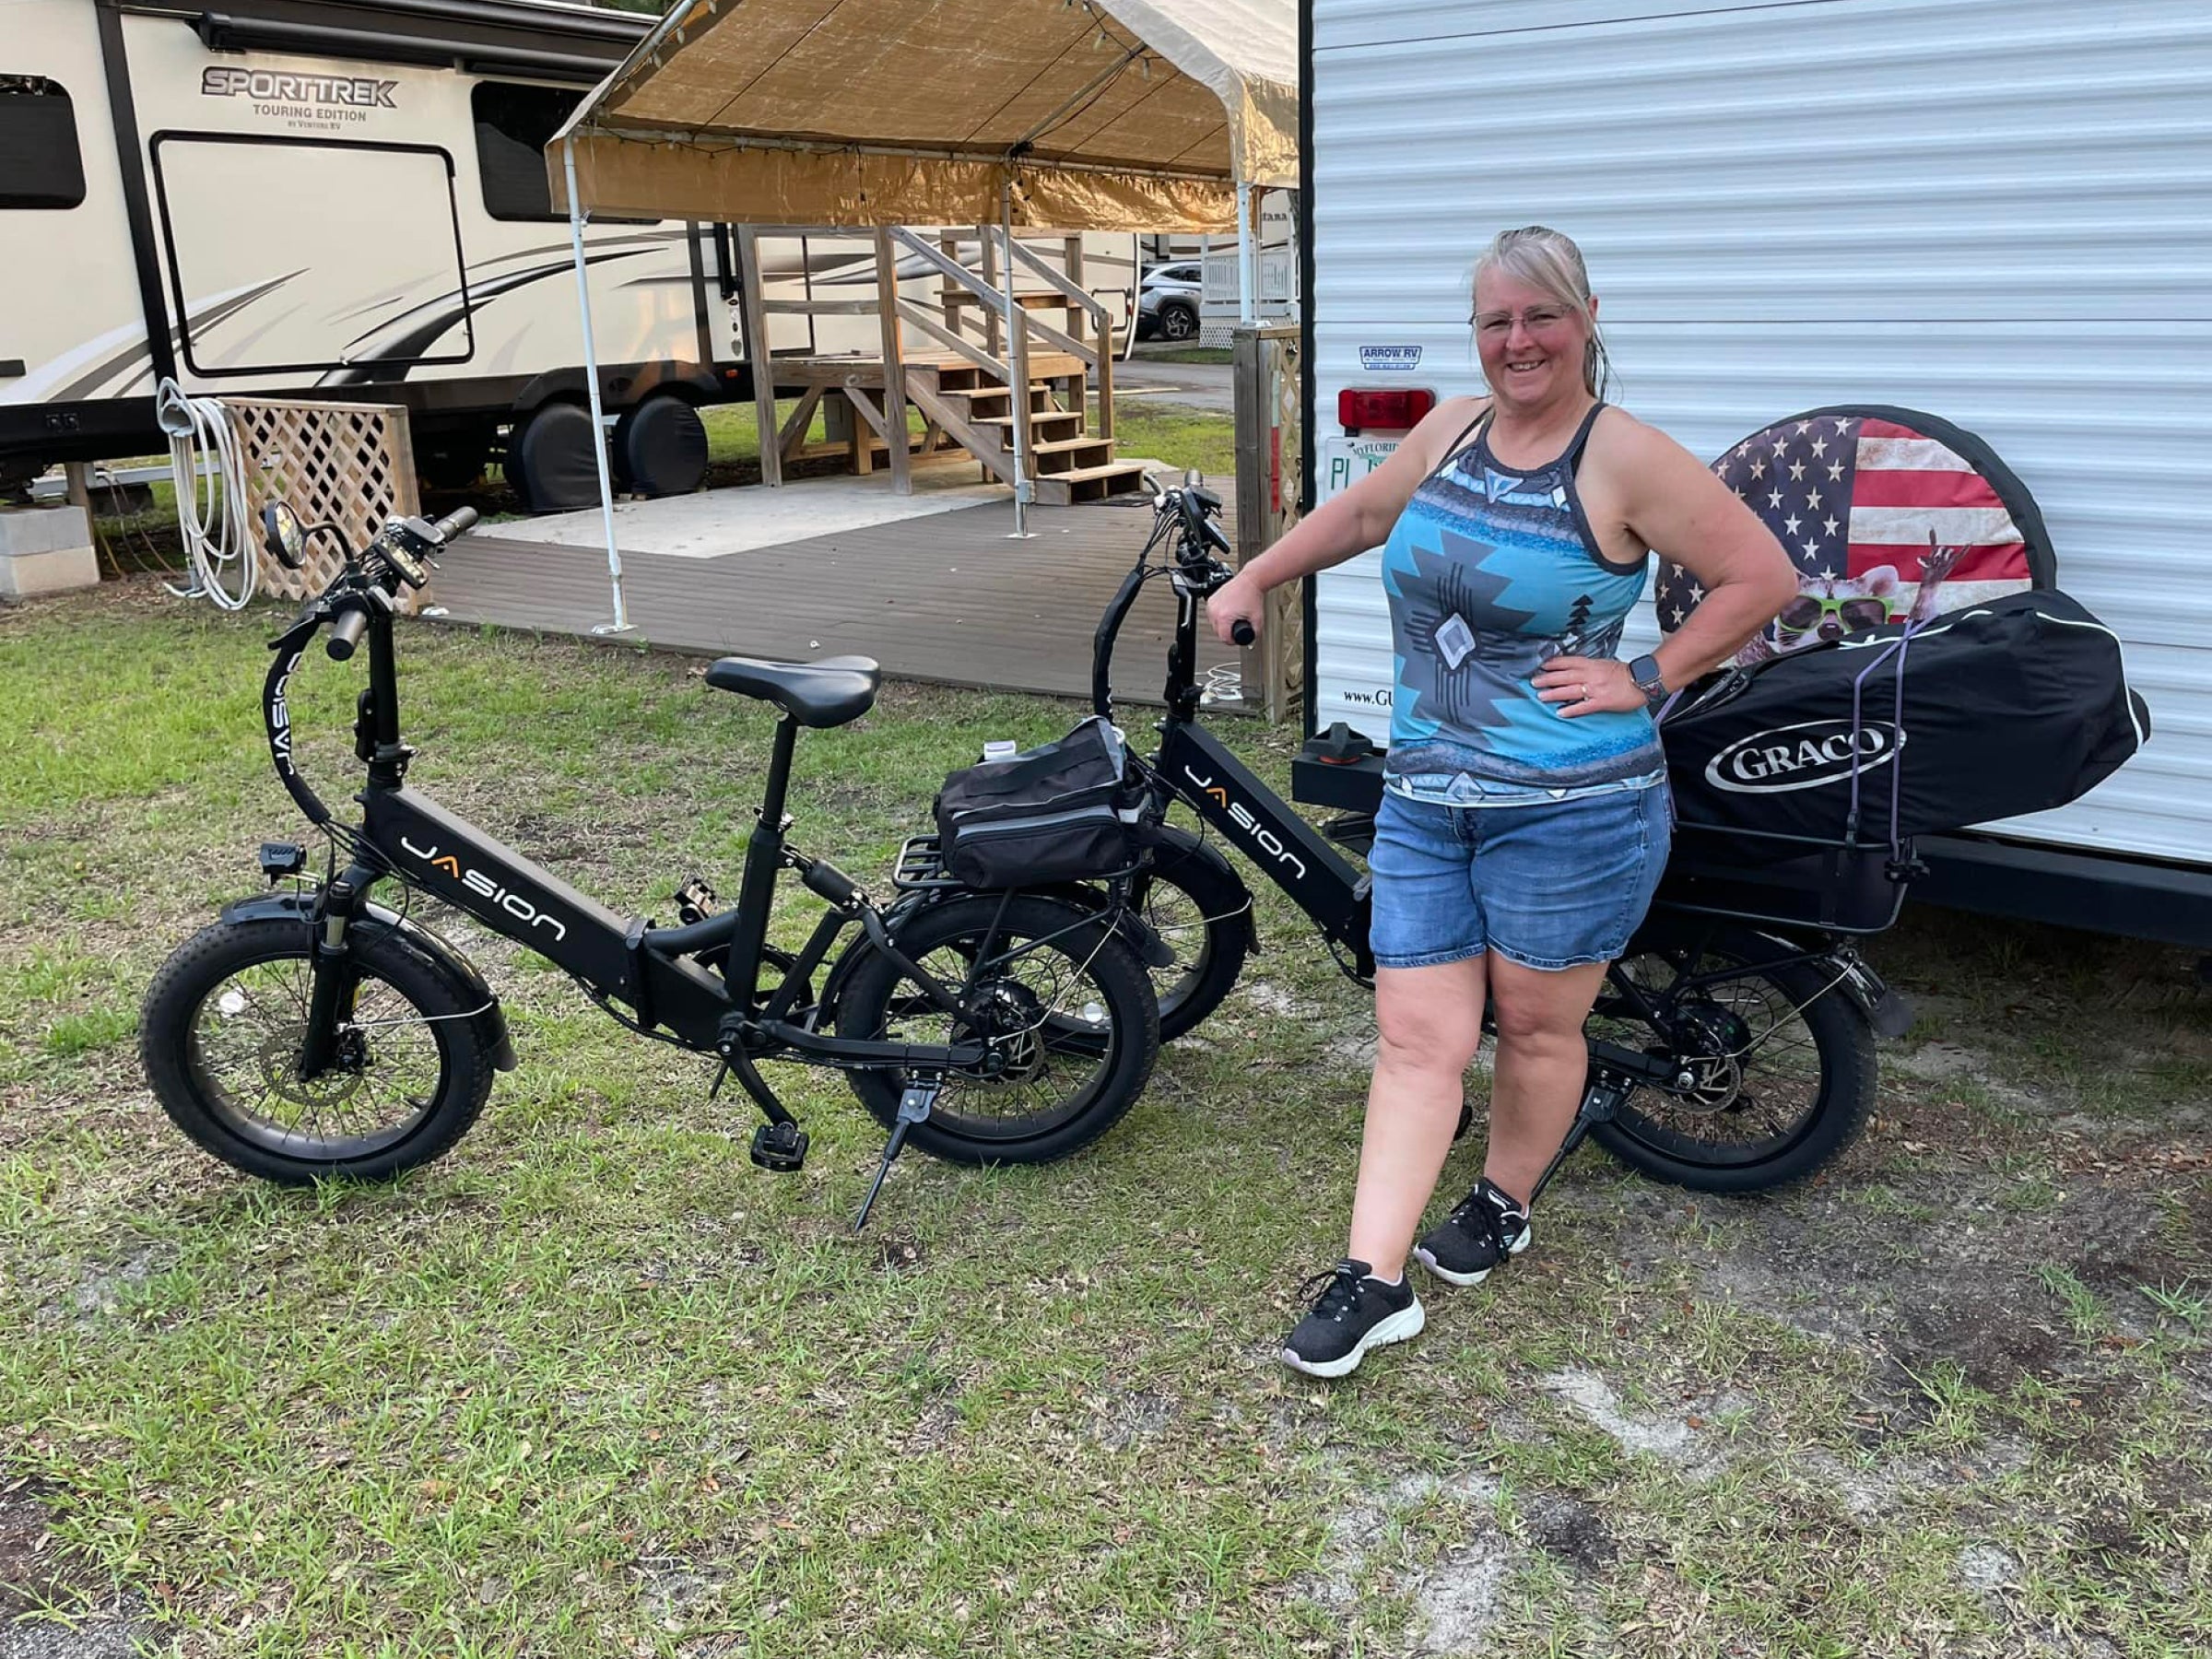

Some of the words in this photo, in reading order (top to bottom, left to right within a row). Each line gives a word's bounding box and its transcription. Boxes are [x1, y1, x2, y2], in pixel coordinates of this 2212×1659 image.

[202, 66, 399, 108] SPORTTREK
[253, 104, 312, 118] TOURING
[316, 108, 366, 122] EDITION
[1363, 348, 1401, 358] ARROW
[1404, 348, 1418, 358] RV
[1733, 727, 1885, 780] GRACO
